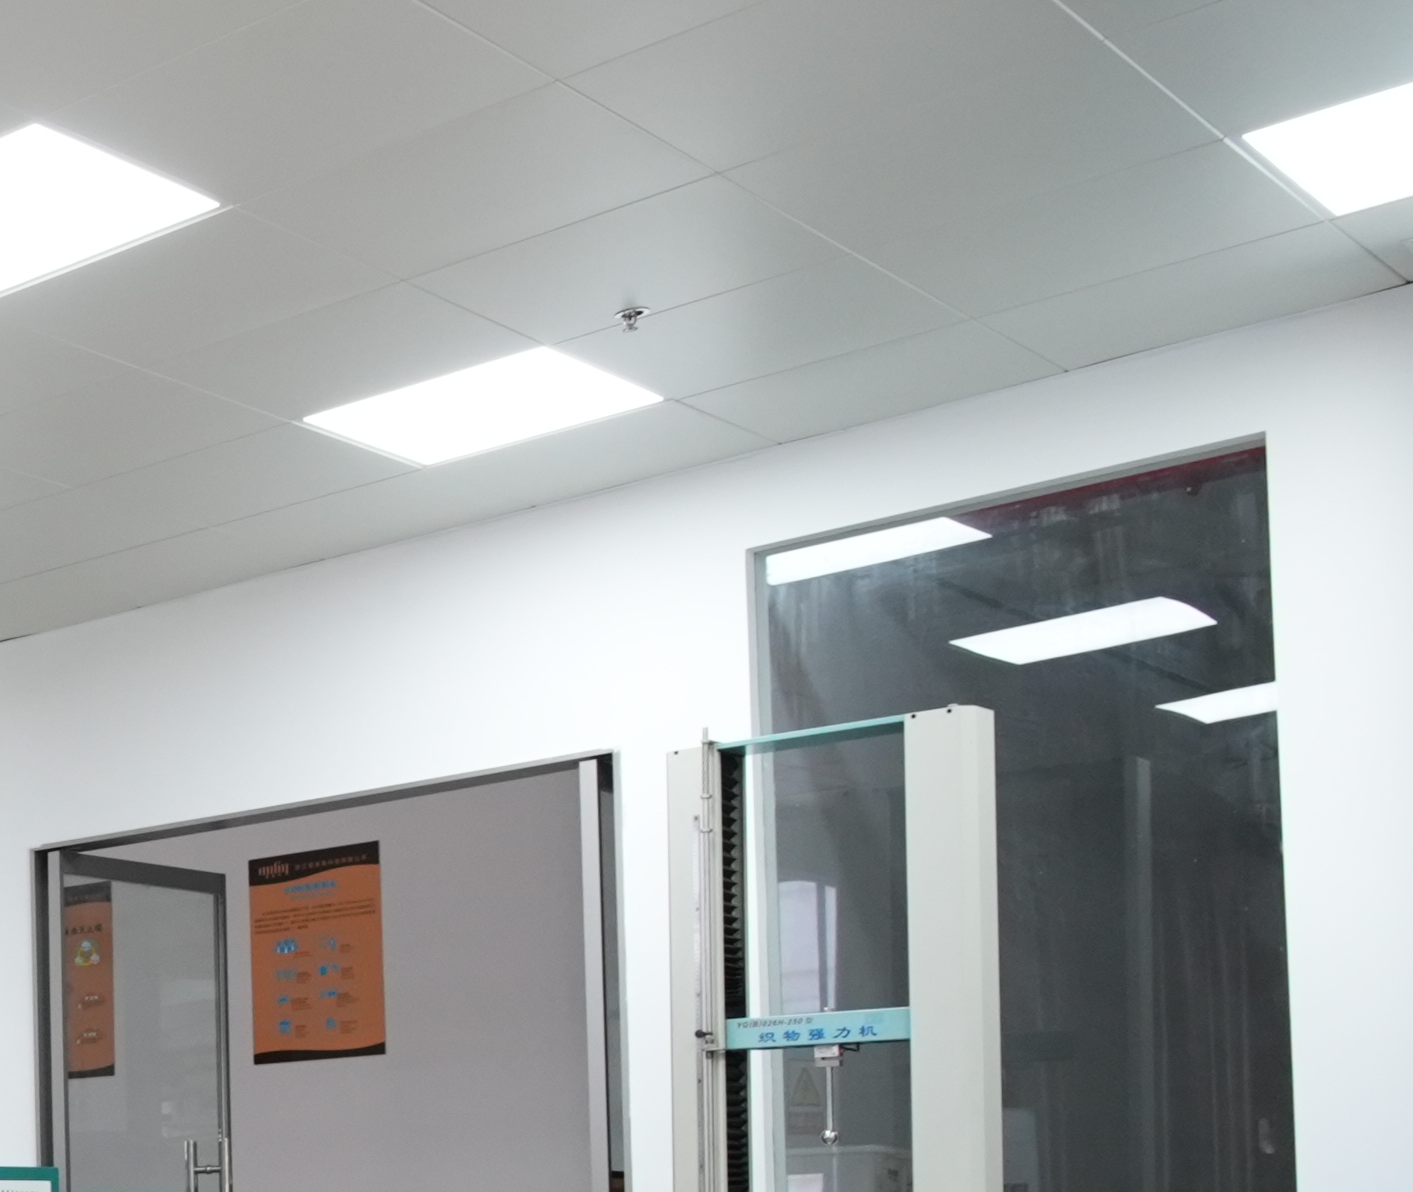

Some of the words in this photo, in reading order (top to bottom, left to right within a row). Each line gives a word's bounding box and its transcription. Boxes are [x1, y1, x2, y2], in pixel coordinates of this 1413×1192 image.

[758, 1026, 877, 1043] 织物强力机
